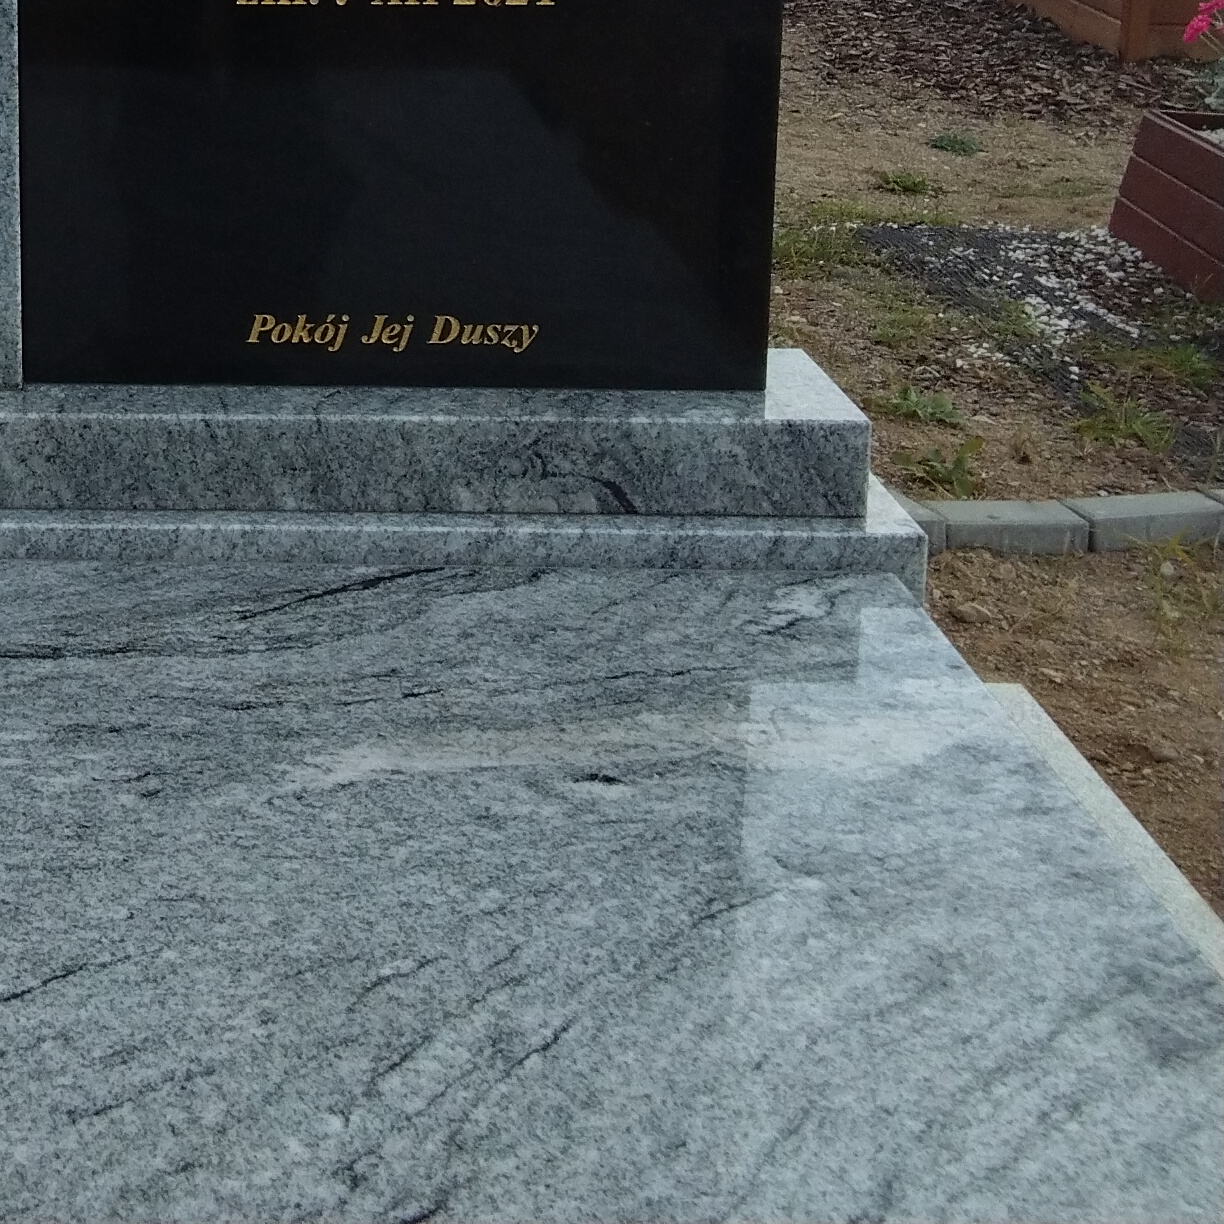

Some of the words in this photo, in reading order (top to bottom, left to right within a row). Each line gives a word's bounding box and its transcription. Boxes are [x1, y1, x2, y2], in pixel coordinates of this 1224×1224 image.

[246, 314, 350, 352] Pokój
[361, 314, 415, 352] Jej
[426, 315, 540, 353] Duszy
